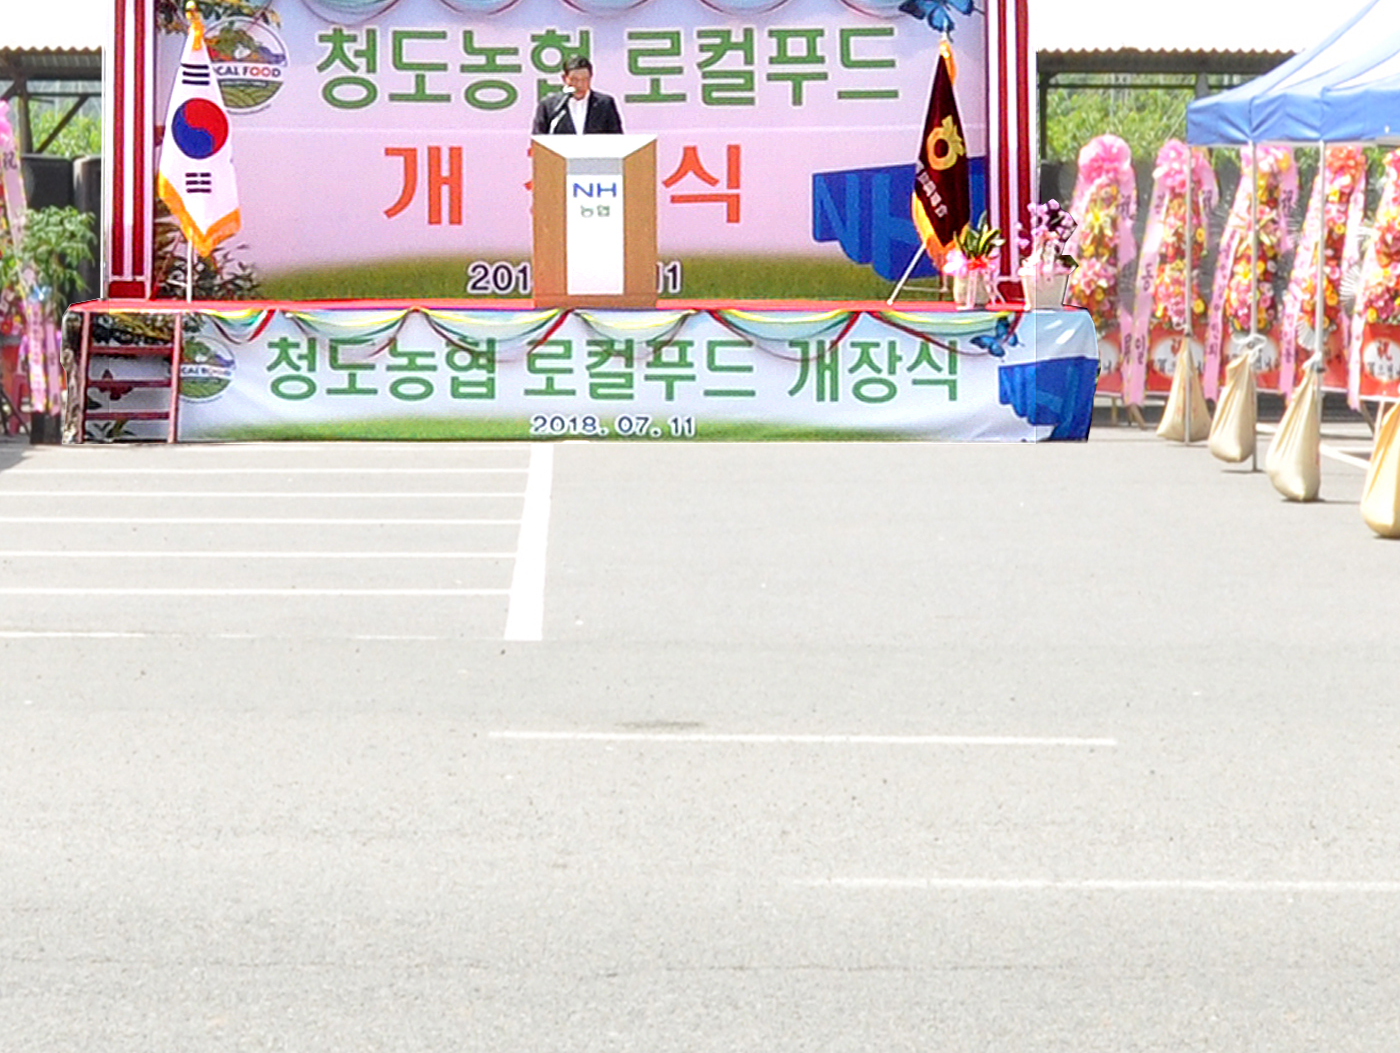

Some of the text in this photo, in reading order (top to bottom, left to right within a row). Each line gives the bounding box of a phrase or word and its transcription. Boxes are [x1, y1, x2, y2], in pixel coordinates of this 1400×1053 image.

[243, 66, 281, 78] FOOD
[624, 27, 899, 107] 로컬푸드
[573, 182, 617, 198] NH
[470, 263, 531, 292] 201
[266, 335, 959, 404] 청도농협 로컬푸드 개장식
[531, 415, 696, 436] 2018. 07. 11
